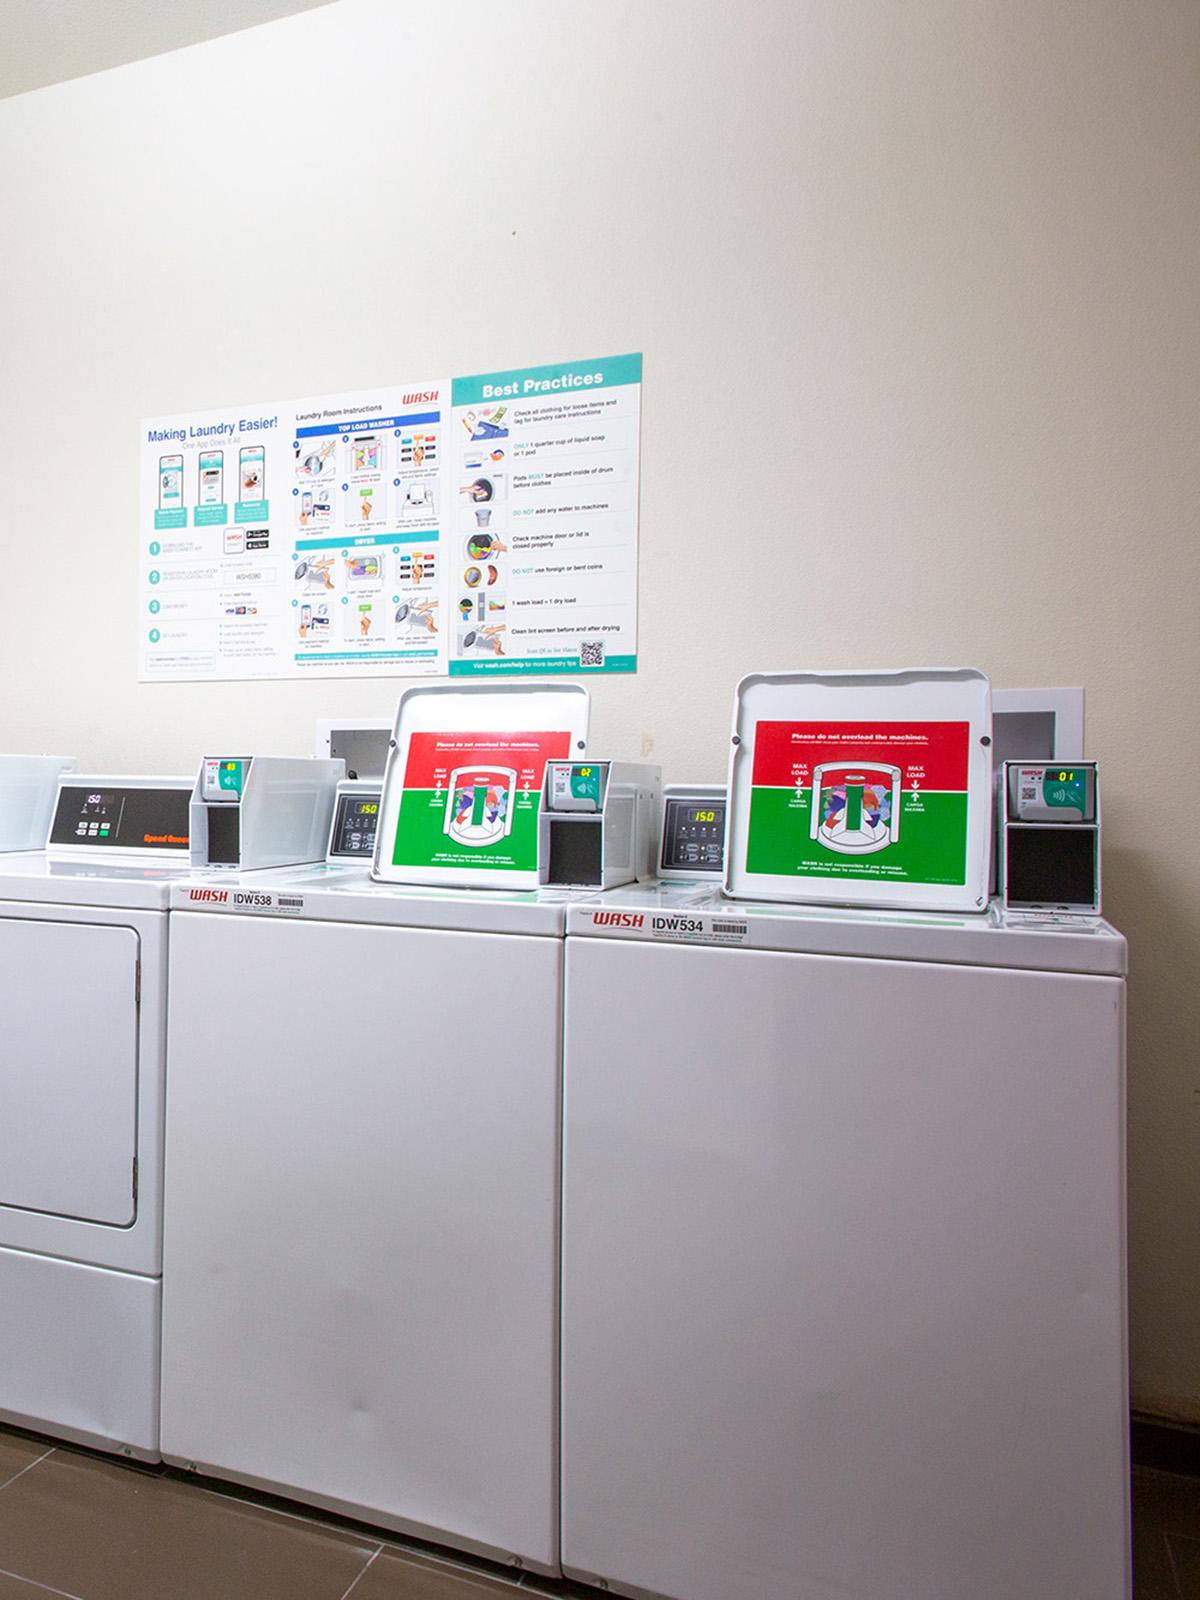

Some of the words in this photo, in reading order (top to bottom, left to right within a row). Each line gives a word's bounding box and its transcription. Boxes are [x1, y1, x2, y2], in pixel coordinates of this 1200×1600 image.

[482, 382, 519, 398] Best
[523, 372, 604, 392] Practices
[402, 390, 439, 405] WASH
[296, 411, 322, 421] Laundry
[323, 408, 342, 417] Room
[343, 404, 382, 414] Instructions
[533, 414, 553, 423] laundry
[568, 409, 601, 418] instructions
[540, 406, 563, 415] clothing
[148, 429, 186, 442] Making
[189, 422, 235, 437] Laundry
[239, 416, 278, 432] Easier!
[352, 423, 368, 431] LOAD
[369, 420, 395, 429] WASHER
[534, 440, 554, 448] quarter
[574, 436, 590, 444] liquid
[553, 471, 571, 479] placed
[531, 479, 551, 487] clothes
[531, 541, 554, 550] properly
[545, 565, 565, 573] foreign
[1059, 772, 1073, 781] 01
[362, 804, 377, 814] 150
[695, 811, 715, 822] 150
[143, 834, 167, 843] Speed
[190, 889, 228, 902] WASH
[233, 893, 272, 905] IDW538
[593, 912, 644, 927] WASH
[652, 917, 704, 932] IDW534
